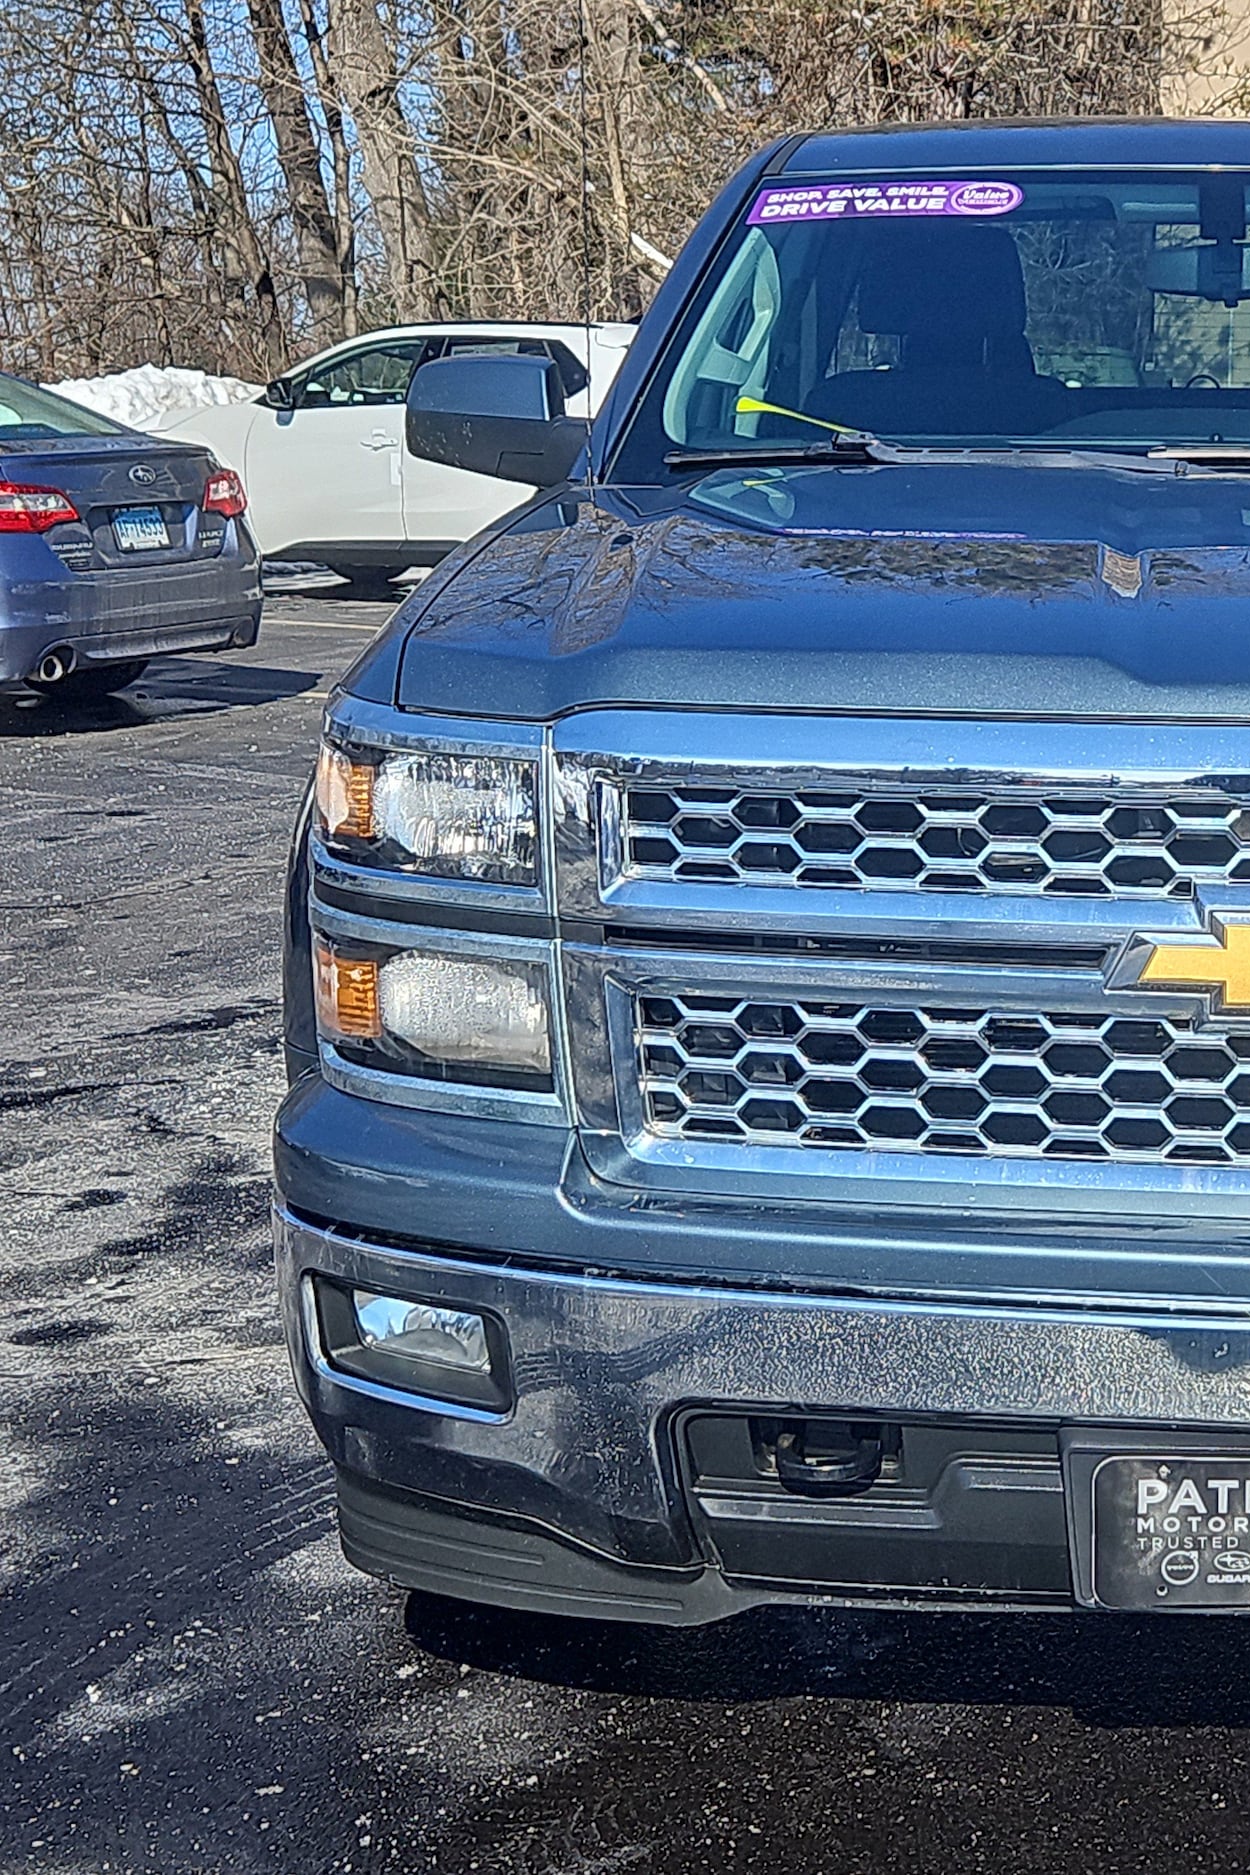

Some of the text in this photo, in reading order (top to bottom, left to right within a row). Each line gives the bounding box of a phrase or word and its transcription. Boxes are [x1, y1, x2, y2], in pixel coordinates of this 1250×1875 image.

[760, 200, 847, 217] DRIVE
[854, 197, 948, 212] VALUE
[1137, 1516, 1249, 1534] MOTOR
[1137, 1536, 1240, 1551] TRUSTED
